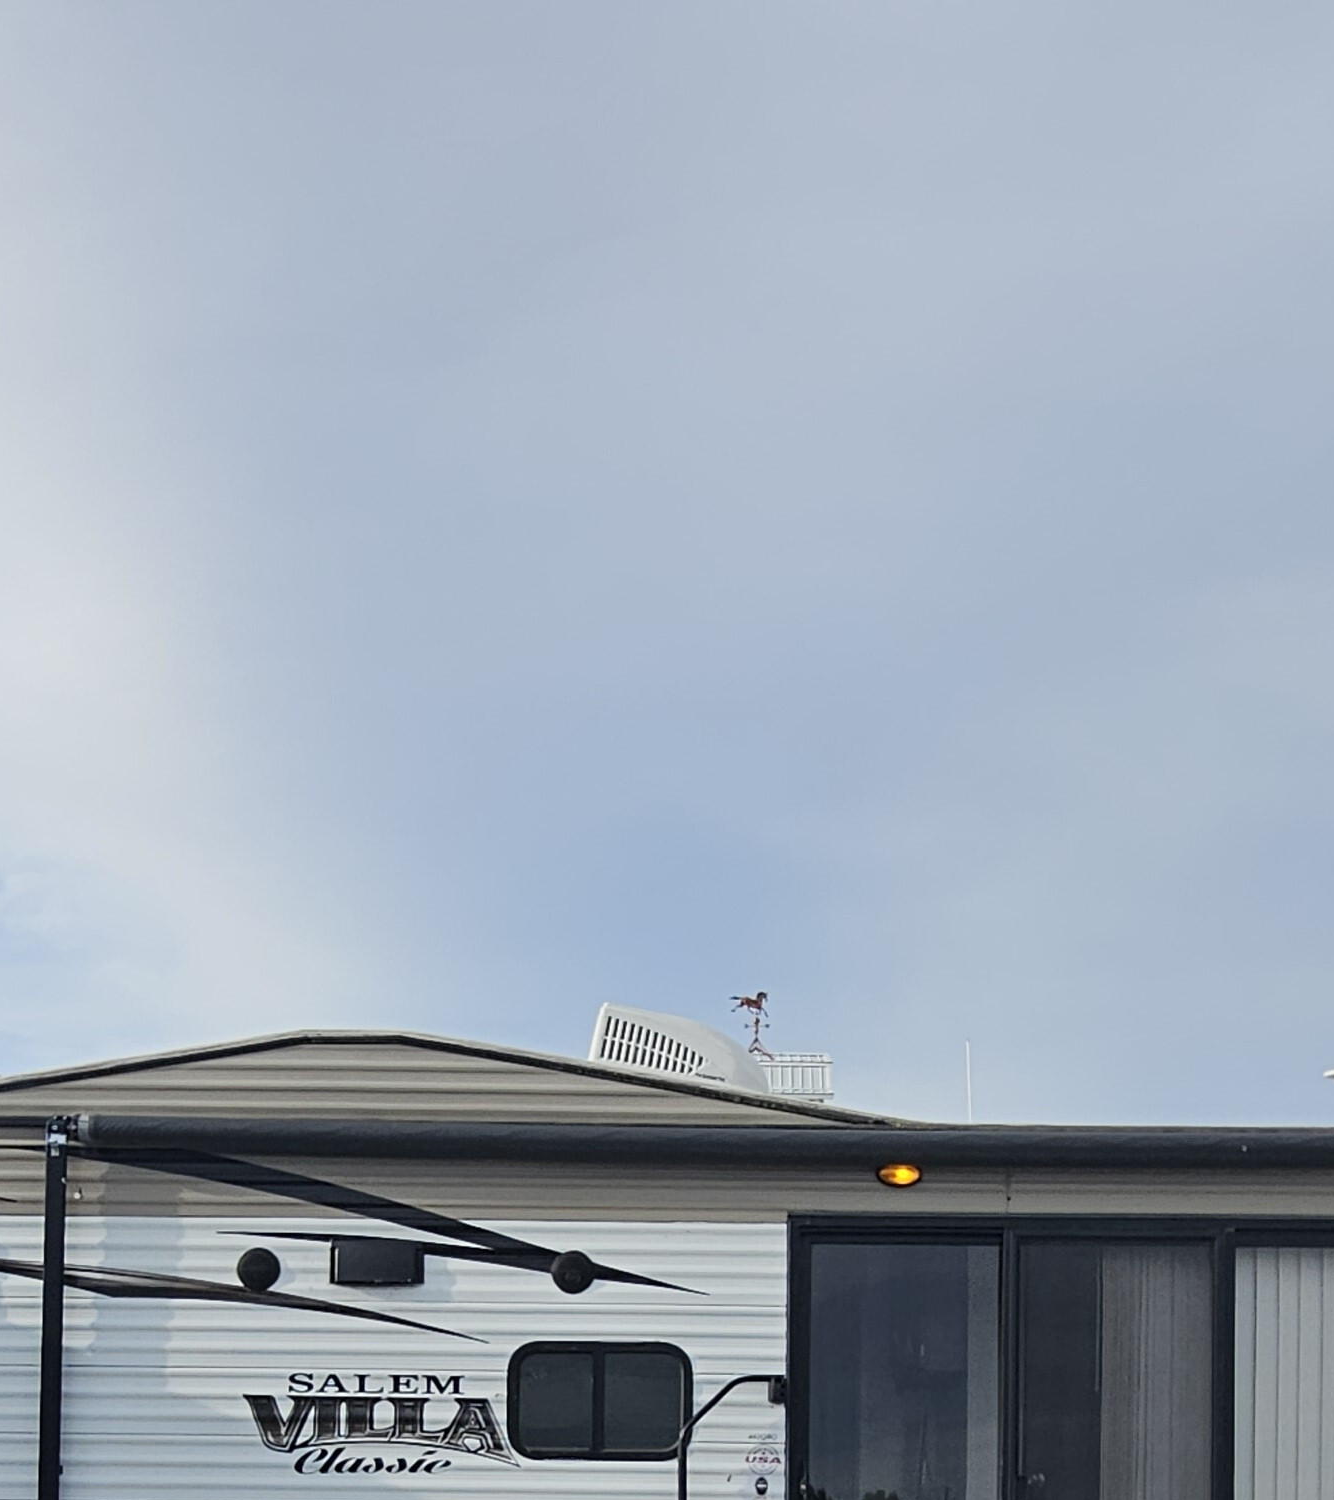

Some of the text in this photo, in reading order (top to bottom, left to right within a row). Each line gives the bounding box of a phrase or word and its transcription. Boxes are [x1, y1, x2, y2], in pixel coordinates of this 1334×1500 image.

[288, 1373, 465, 1395] SALEM
[243, 1394, 521, 1468] VILLA
[294, 1448, 452, 1475] Classic
[745, 1455, 782, 1464] USA
